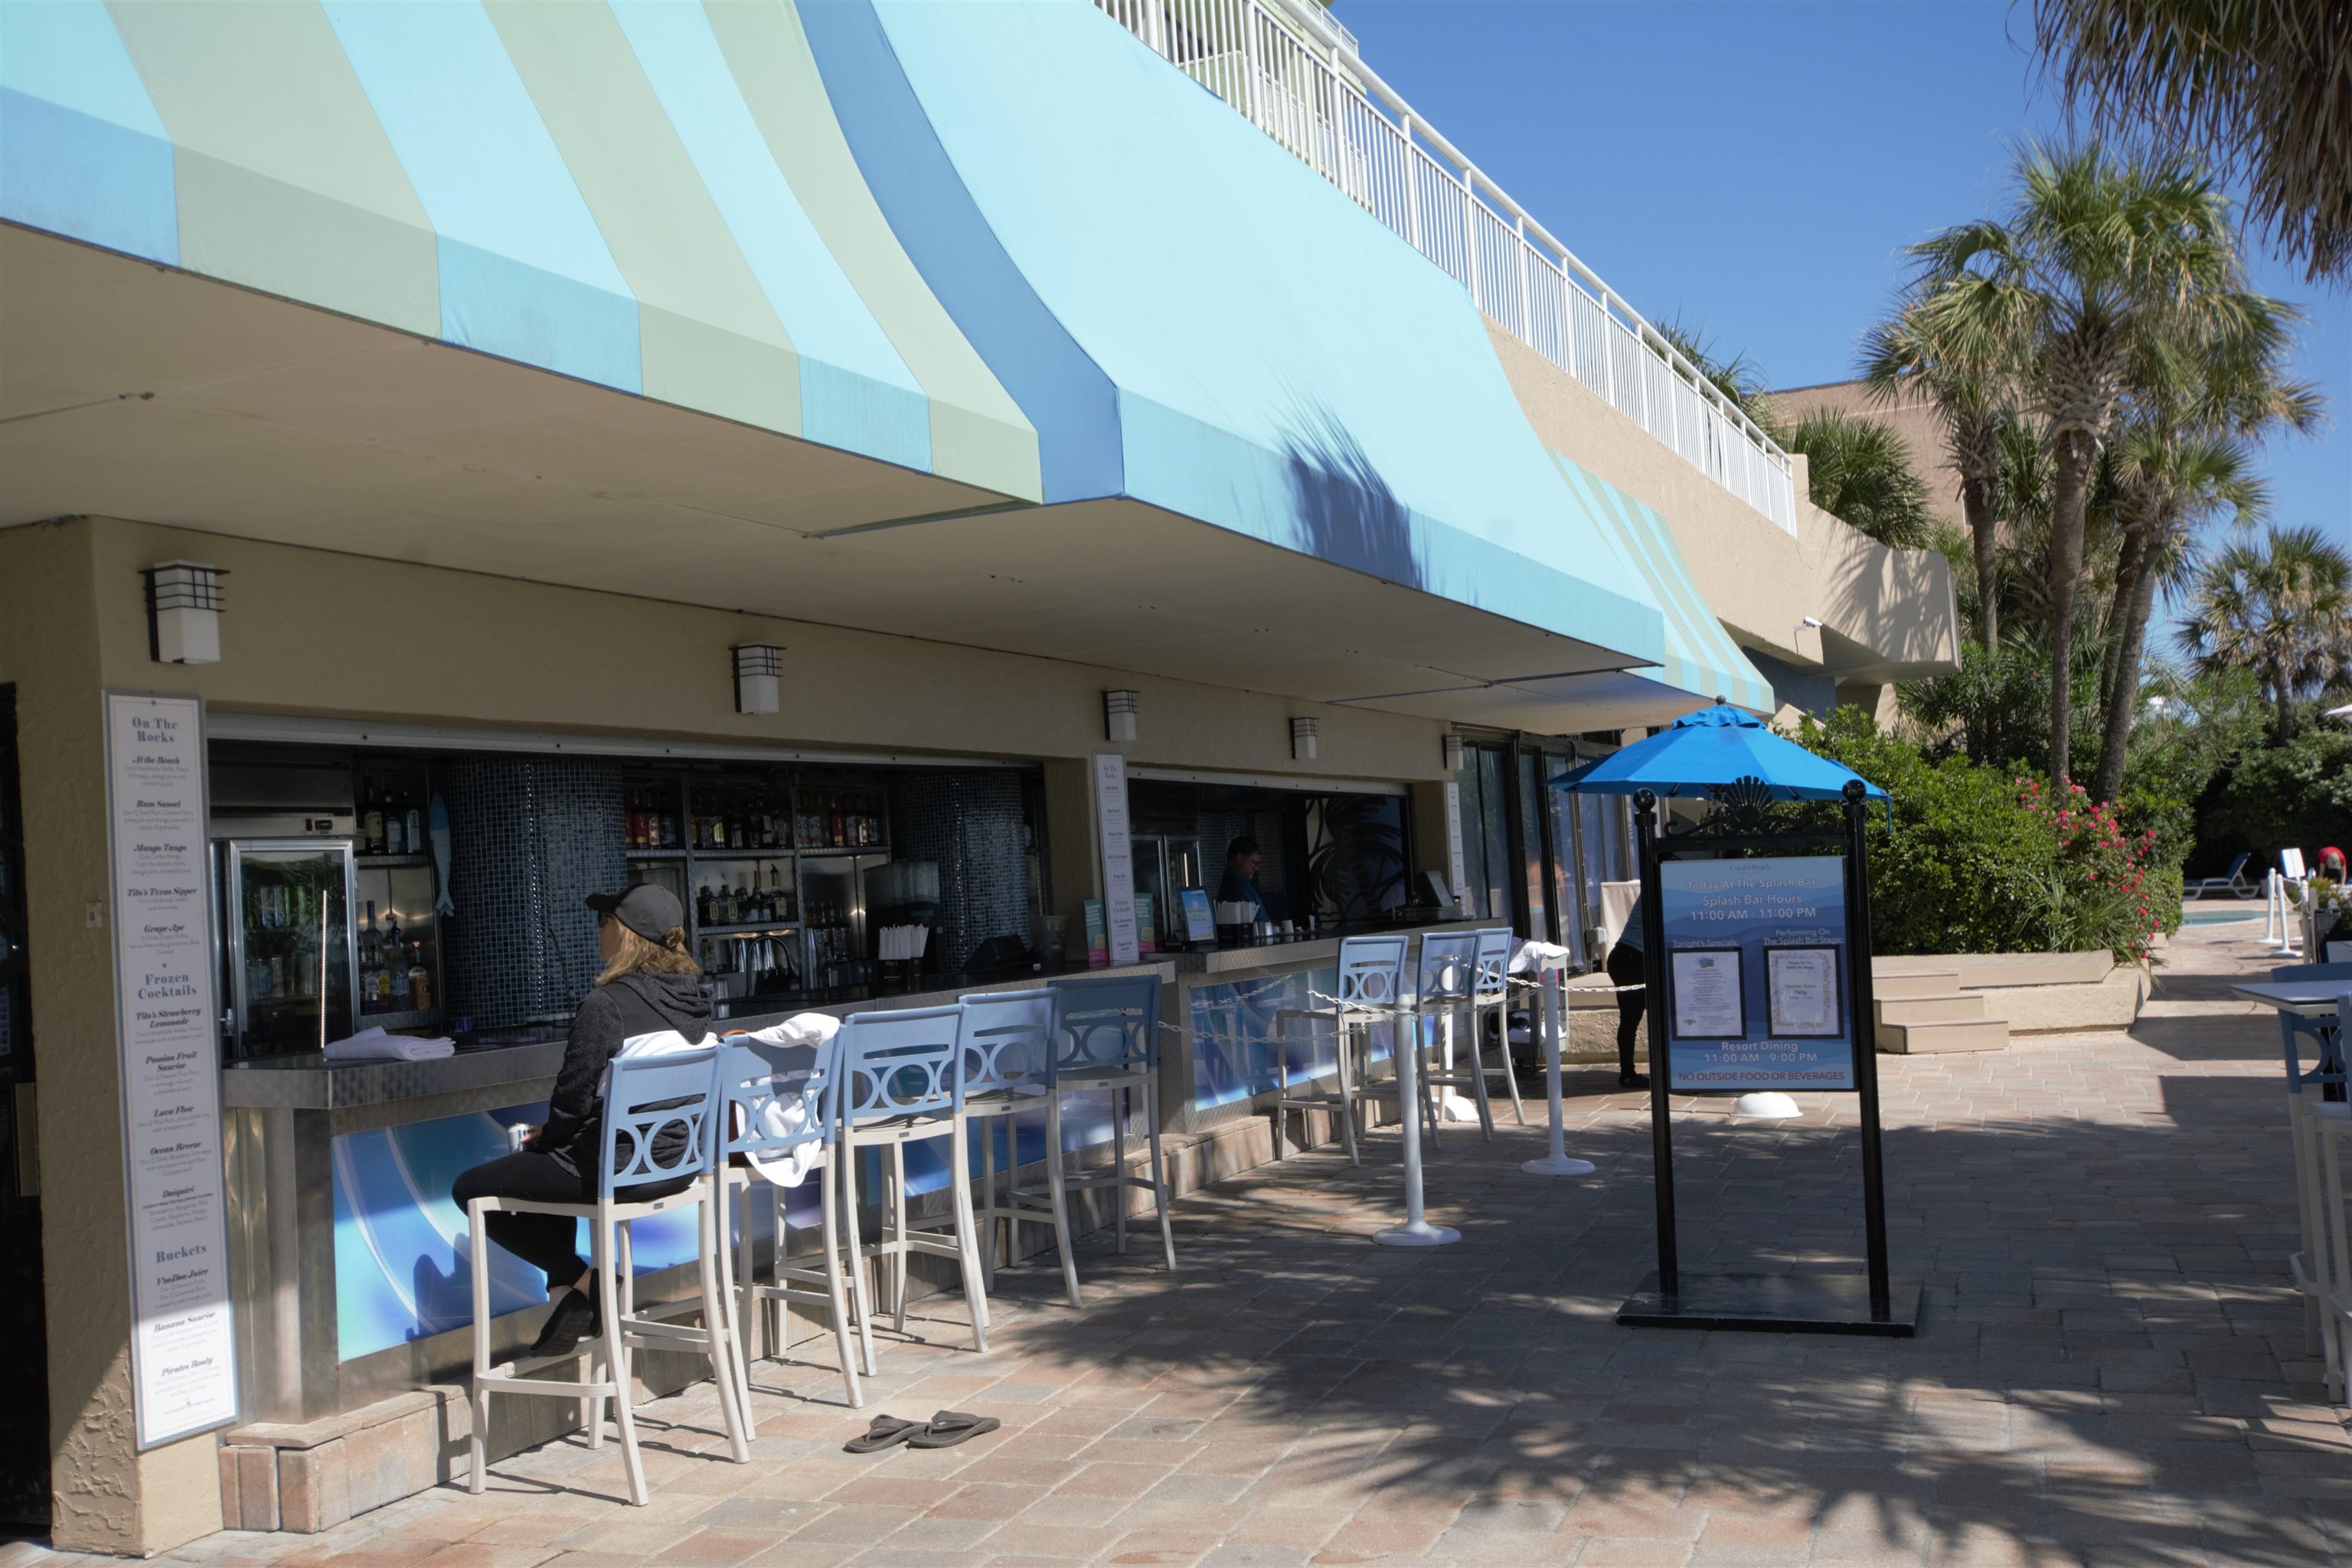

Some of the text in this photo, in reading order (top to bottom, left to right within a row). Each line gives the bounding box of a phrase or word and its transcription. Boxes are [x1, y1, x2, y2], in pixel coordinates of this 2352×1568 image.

[132, 717, 178, 730] On The
[137, 730, 175, 743] Rocks
[136, 799, 155, 808] Rum
[133, 844, 187, 853] Mango Tango
[1687, 877, 1815, 892] Today At The Splash Bar
[127, 888, 148, 897] Tito's
[173, 887, 198, 897] Sipper
[1702, 894, 1802, 906] Splash Bar Hours
[1690, 910, 1723, 921] 11:00
[1727, 910, 1748, 920] AM
[1759, 908, 1793, 919] 11:00
[1796, 907, 1815, 917] PM
[144, 923, 185, 934] Grape Ape
[1775, 929, 1816, 938] Performing
[1672, 938, 1740, 948] Tonight's Specials:
[1779, 937, 1804, 946] Splash
[1820, 936, 1844, 945] Stage:
[145, 973, 189, 985] Frozen
[138, 985, 197, 999] Cocktails
[136, 1008, 201, 1020] Tito's Strawberry
[150, 1018, 189, 1028] Lemonade
[1721, 1041, 1798, 1052] Resort Dining
[145, 1050, 197, 1064] Passion Fruit
[1704, 1054, 1737, 1063] 11:00
[1740, 1054, 1759, 1062] AM
[1769, 1054, 1795, 1062] 9:00
[1798, 1053, 1818, 1062] PM
[157, 1062, 187, 1072] Sunrise
[1678, 1073, 1694, 1081] NO
[1771, 1072, 1785, 1080] OR
[1788, 1072, 1844, 1080] BEVERAGES
[154, 1106, 194, 1118] Lava Flow
[150, 1142, 201, 1155] Ocean Breeze
[162, 1184, 195, 1198] Daiquiri
[156, 1244, 207, 1263] Buckets
[157, 1268, 208, 1285] VooDoo Juice
[154, 1320, 185, 1333] Banana
[187, 1311, 216, 1323] Sunrise
[162, 1364, 189, 1377] Pirates
[191, 1357, 213, 1369] Booty
